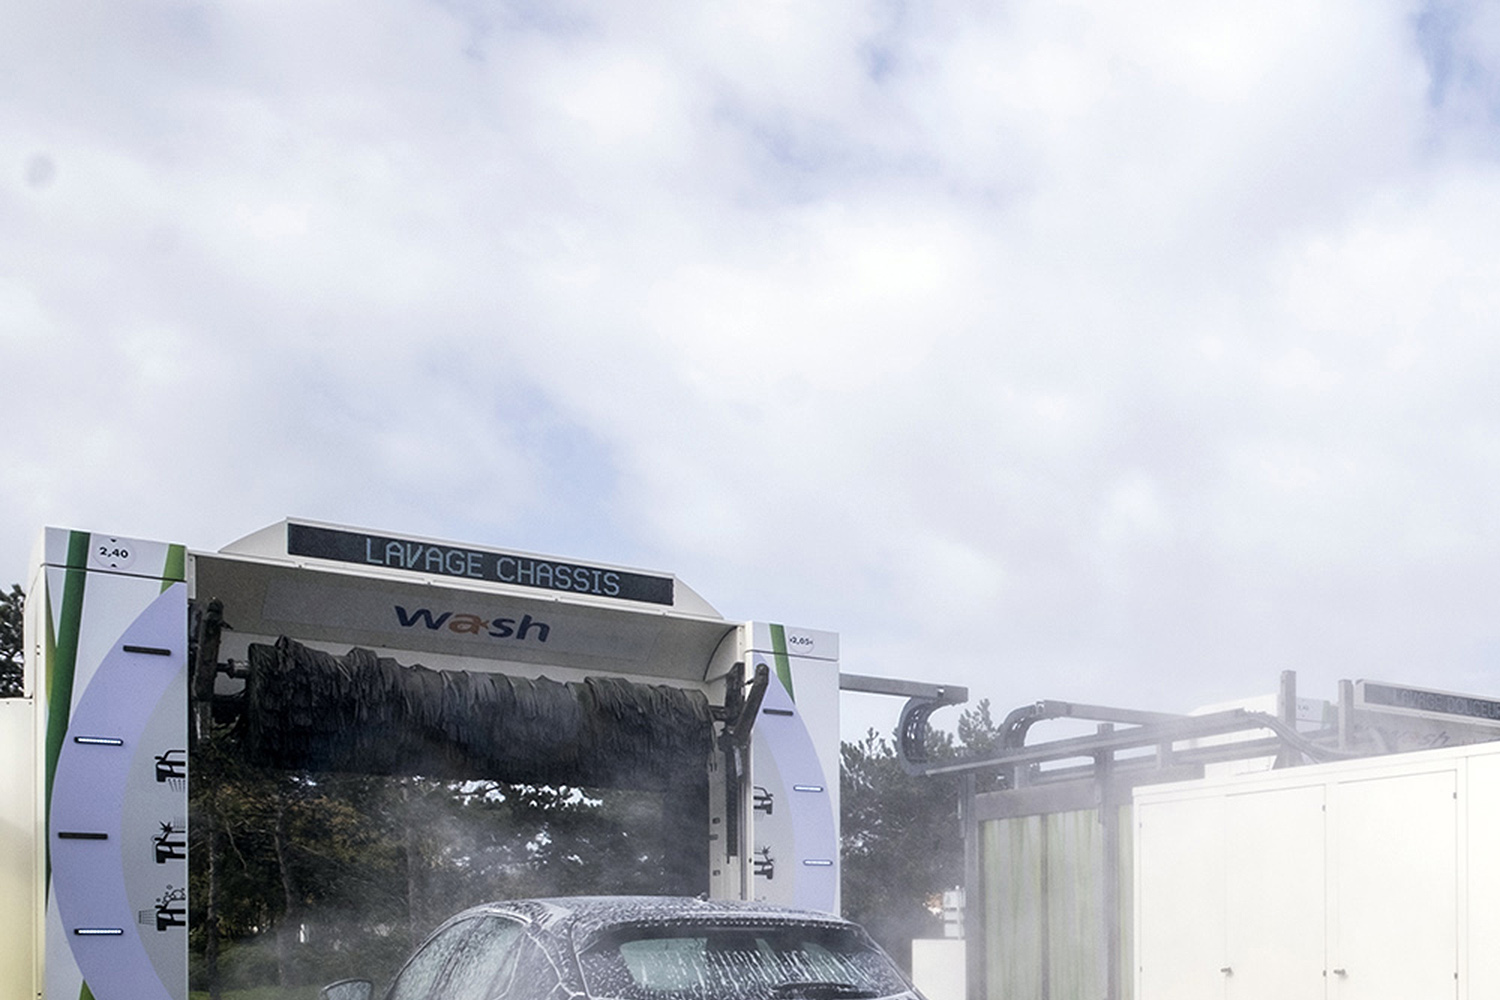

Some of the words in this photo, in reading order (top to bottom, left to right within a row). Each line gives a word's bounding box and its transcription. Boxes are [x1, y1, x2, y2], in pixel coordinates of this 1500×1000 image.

[99, 546, 129, 558] 2,40
[366, 538, 483, 578] LAVAGE
[496, 557, 620, 597] CHASSIS
[394, 605, 550, 643] wash
[1393, 688, 1443, 709] LAVAGE
